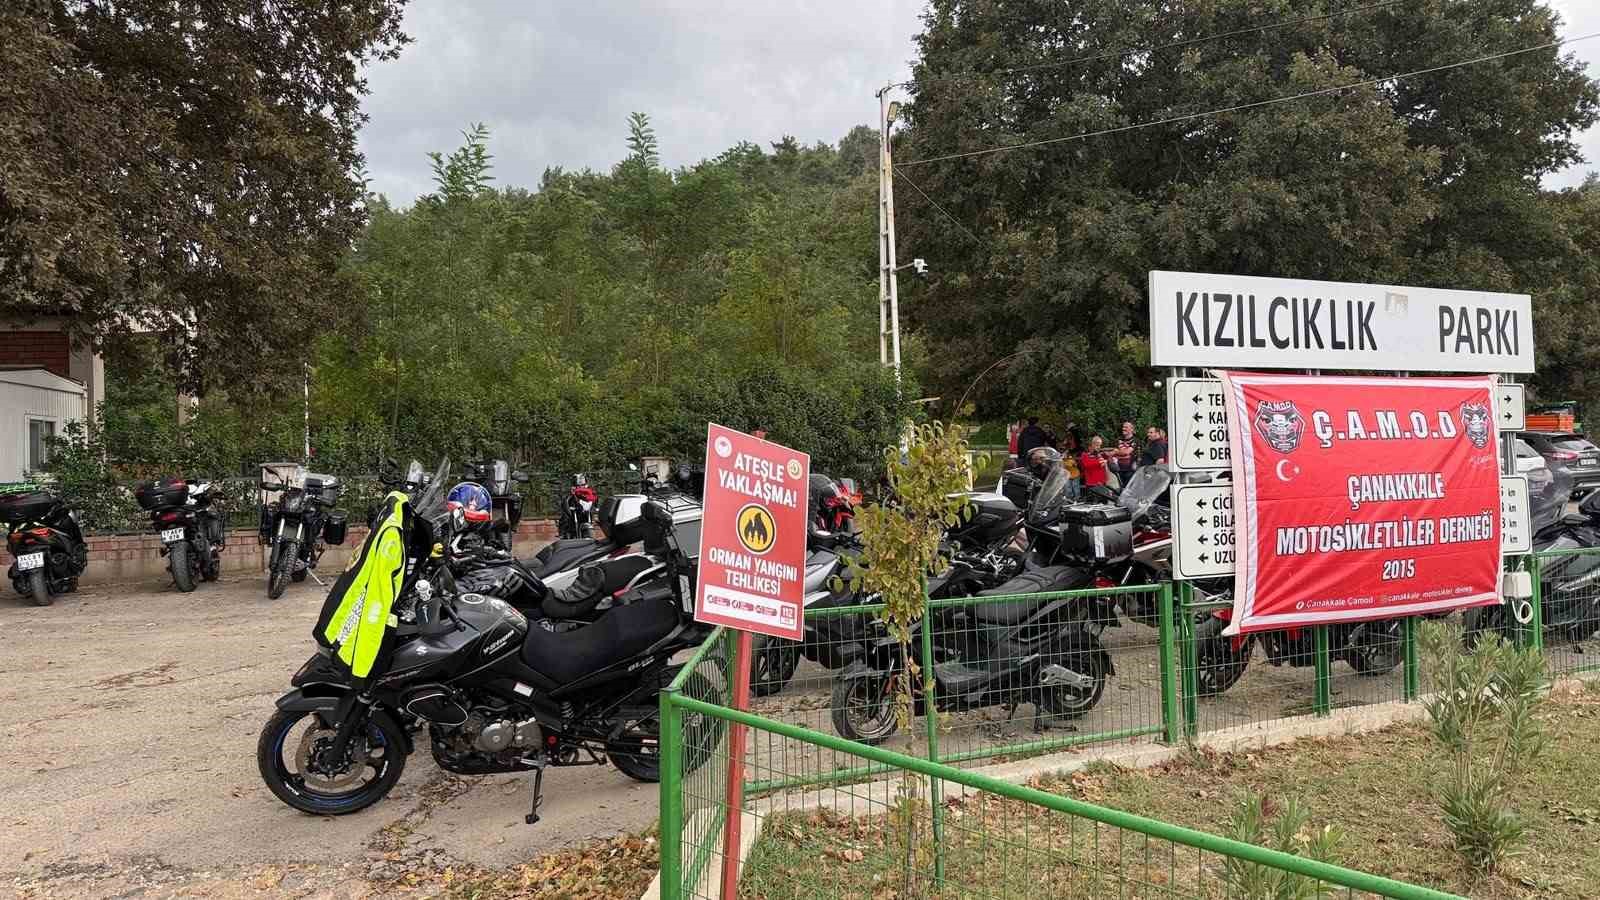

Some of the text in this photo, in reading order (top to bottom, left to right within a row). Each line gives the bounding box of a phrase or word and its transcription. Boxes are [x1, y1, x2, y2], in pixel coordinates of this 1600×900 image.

[1175, 291, 1520, 356] KIZILCIKLIK PARKI
[1311, 408, 1457, 449] Ç.A.M.O.D
[734, 452, 785, 483] ATEŞLE
[1209, 447, 1232, 461] DER
[718, 469, 797, 508] YAKLAŞMA!
[1347, 471, 1446, 511] ÇANAKKALE
[1275, 509, 1494, 556] MOTOSİKLETLİLER DERNEĞİ
[708, 547, 798, 582] ORMAN YANGINI
[725, 569, 782, 596] TEHLİKESİ
[1382, 559, 1416, 582] 2015
